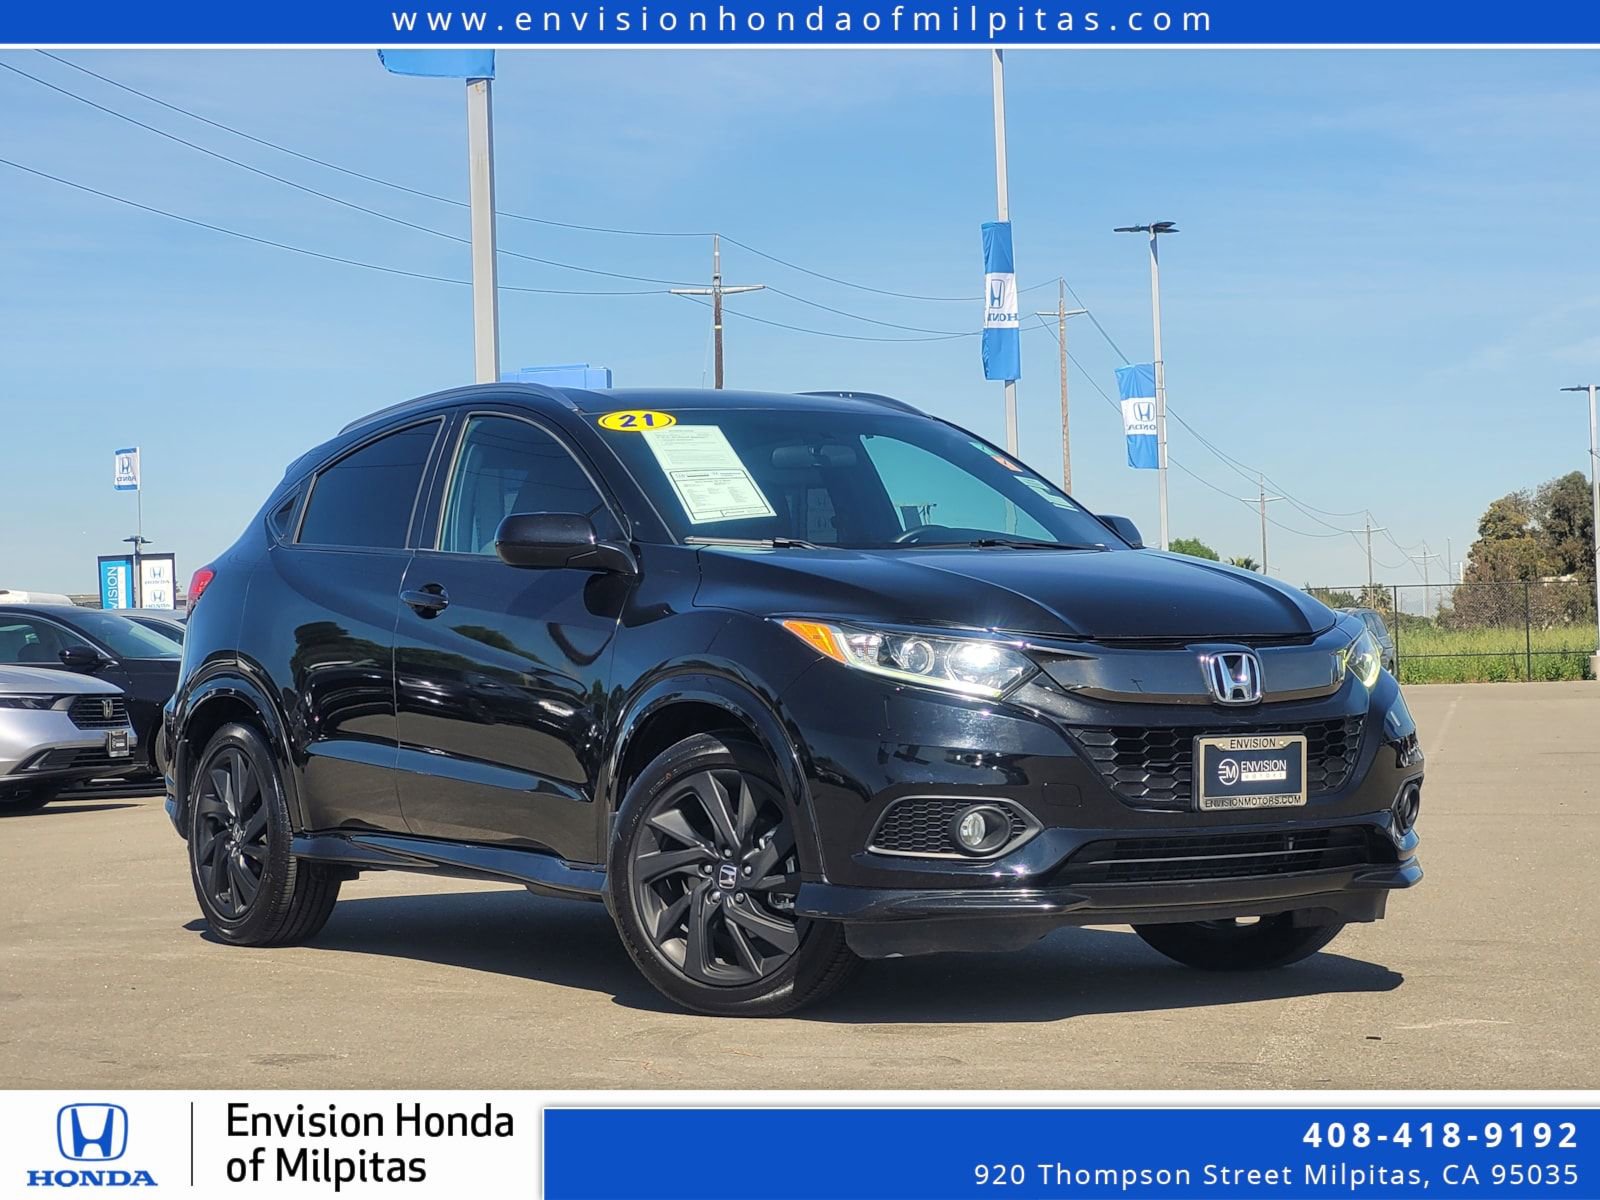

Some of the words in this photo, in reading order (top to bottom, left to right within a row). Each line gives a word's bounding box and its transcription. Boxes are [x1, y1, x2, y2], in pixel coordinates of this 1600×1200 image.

[618, 413, 654, 428] 21
[1230, 738, 1276, 749] ENVISION
[1241, 760, 1287, 773] ENVISION
[1205, 795, 1301, 808] ENVISIONMOTORS.COM
